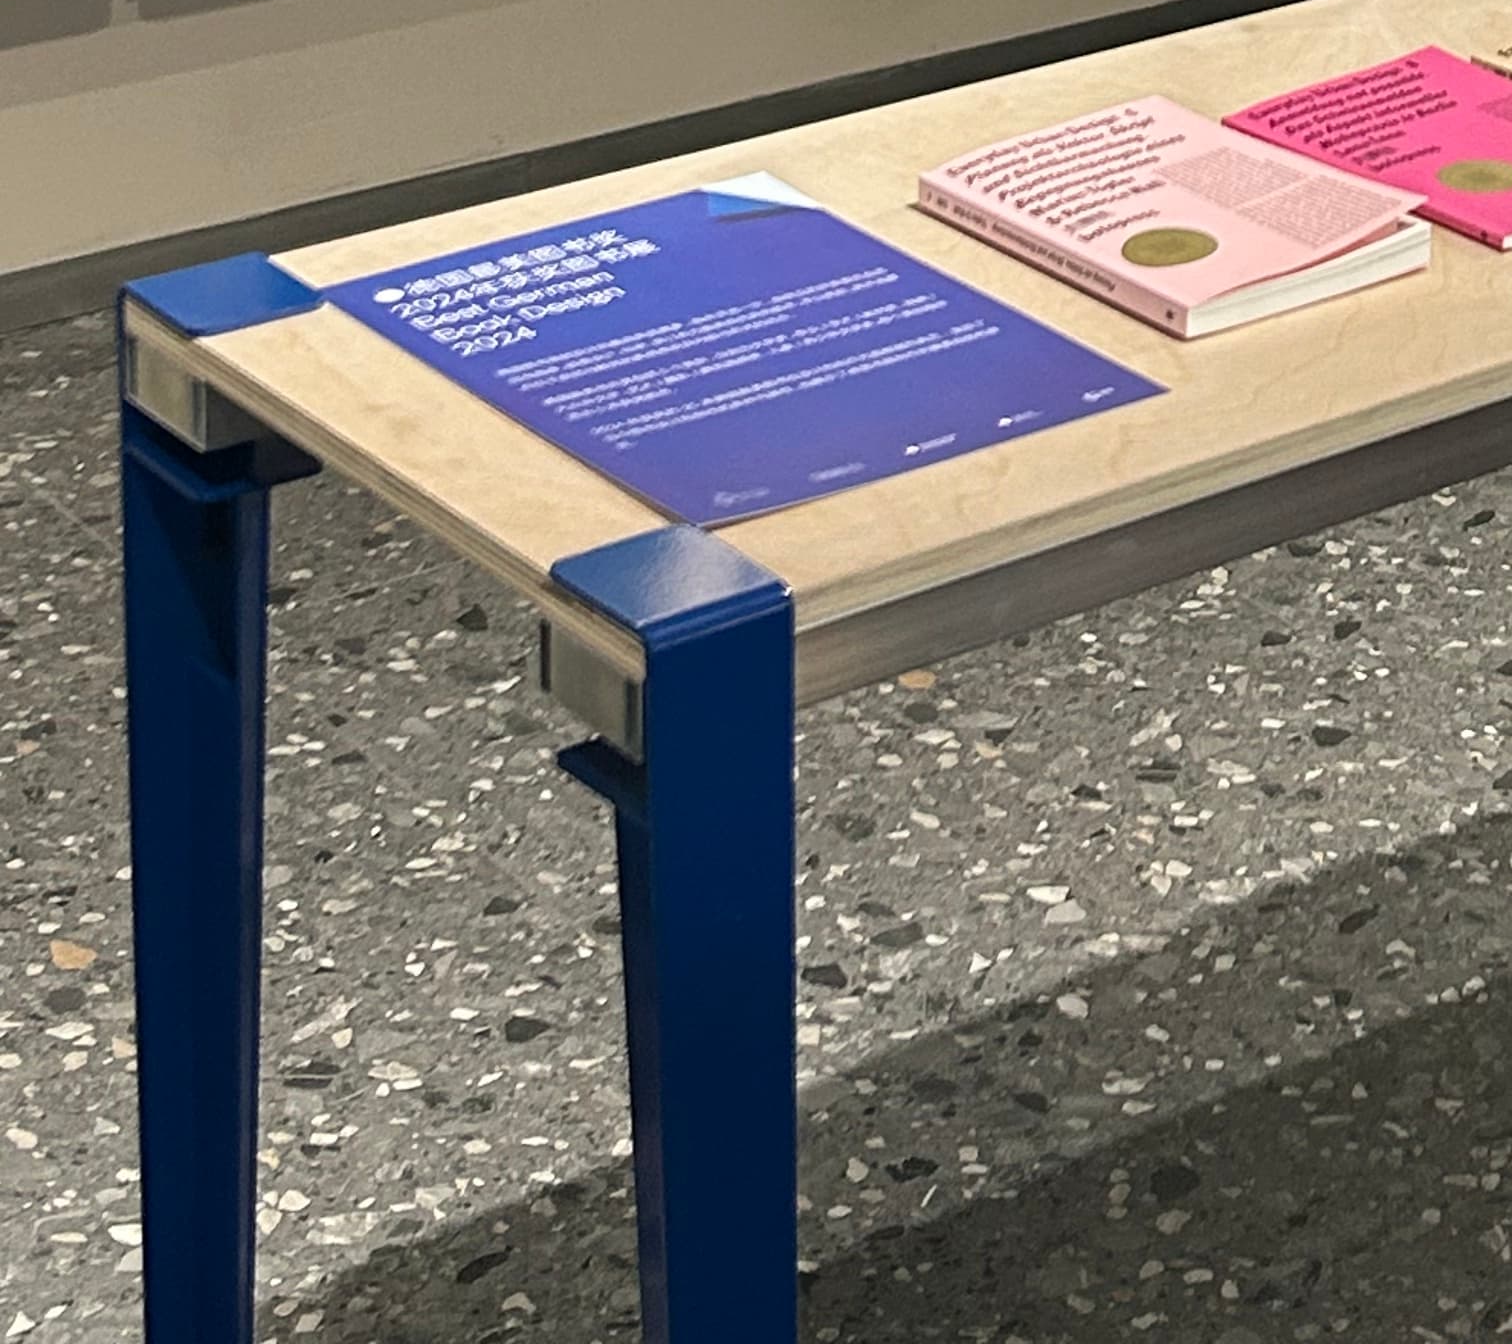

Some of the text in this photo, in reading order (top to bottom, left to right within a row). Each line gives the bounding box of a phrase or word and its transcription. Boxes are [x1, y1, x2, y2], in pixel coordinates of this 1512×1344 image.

[1415, 99, 1459, 119] Berlin
[409, 270, 616, 331] Best German
[429, 285, 627, 345] Book Design
[451, 325, 538, 358] 2024
